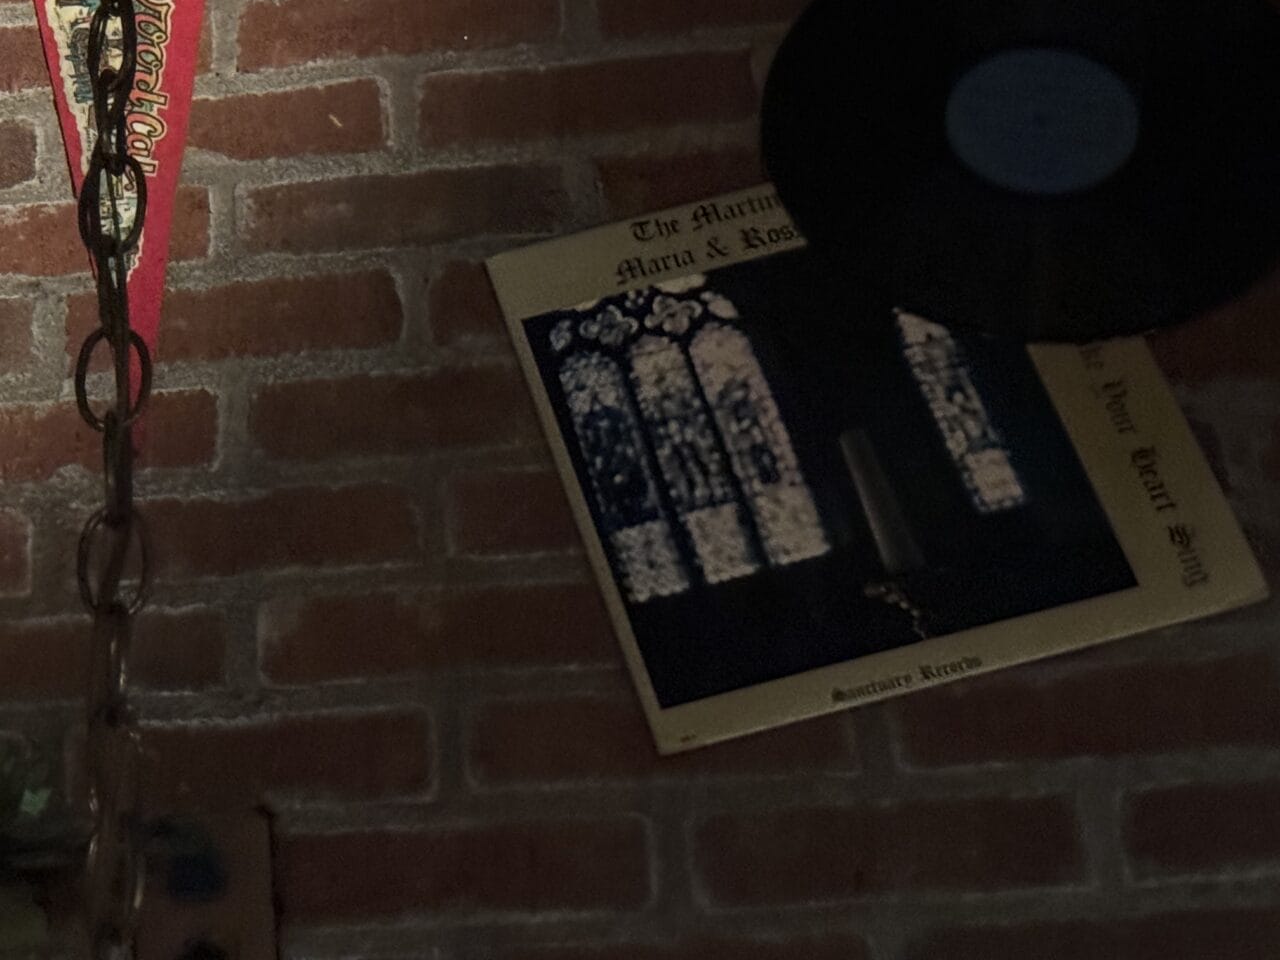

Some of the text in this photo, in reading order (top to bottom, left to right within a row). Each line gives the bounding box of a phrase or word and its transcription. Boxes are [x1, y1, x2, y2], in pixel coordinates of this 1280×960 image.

[631, 218, 680, 242] The
[616, 225, 801, 286] Maria & Ros
[1131, 444, 1177, 512] Heart
[1167, 522, 1209, 588] Sing
[918, 655, 983, 680] Records
